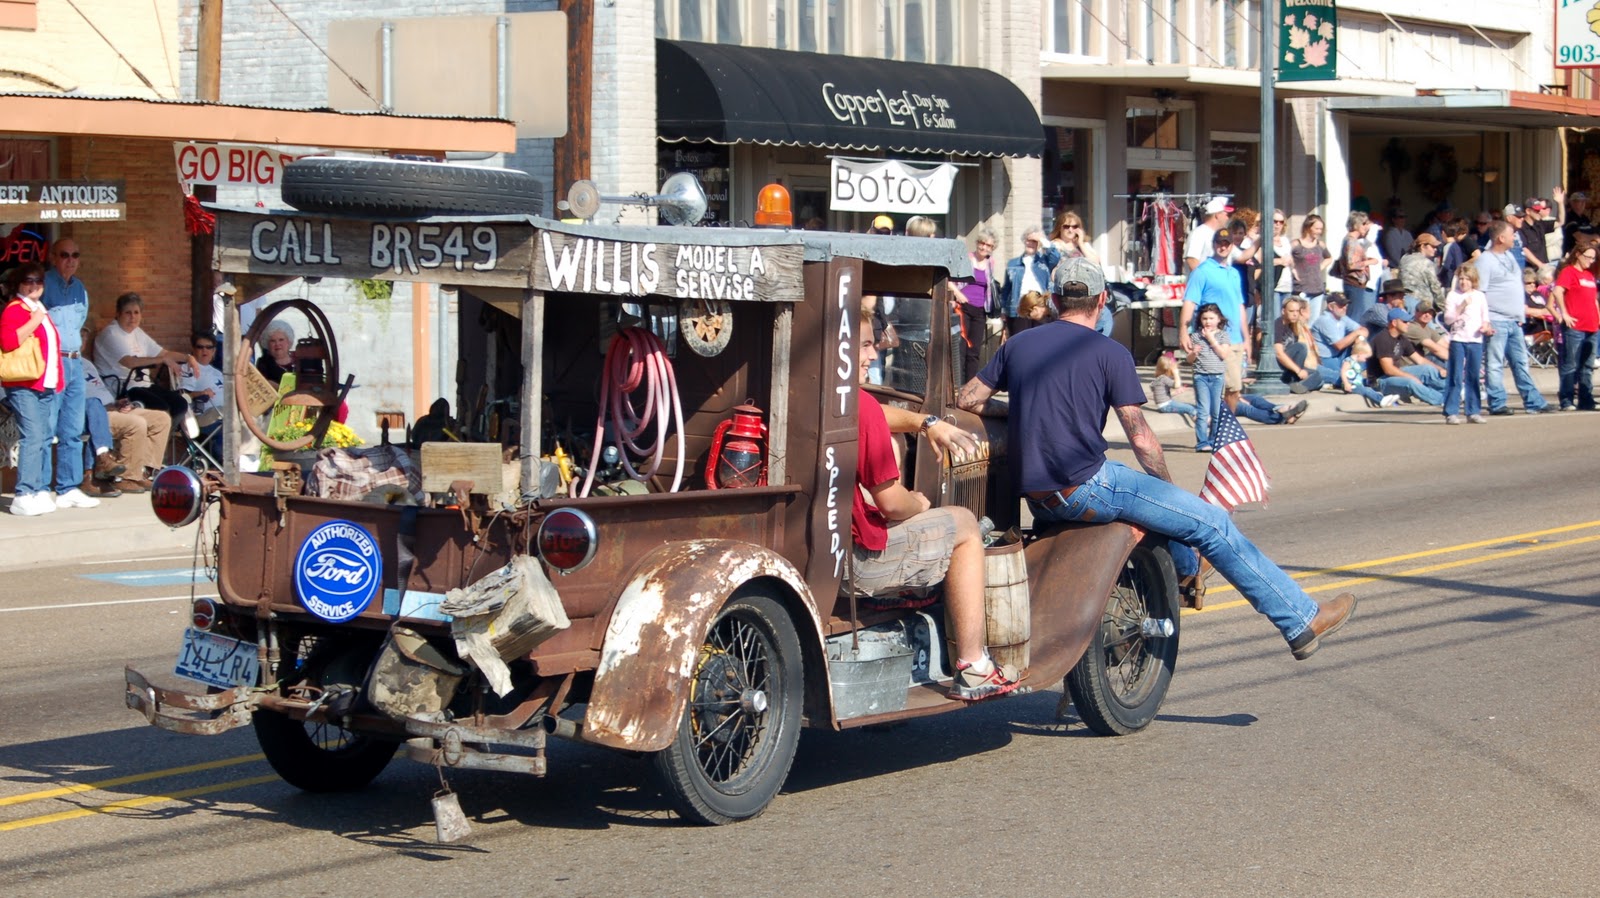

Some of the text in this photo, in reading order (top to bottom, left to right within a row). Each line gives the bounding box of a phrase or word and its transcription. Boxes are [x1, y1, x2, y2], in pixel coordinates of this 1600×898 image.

[912, 94, 932, 111] Day
[931, 94, 950, 112] Spa
[923, 113, 956, 129] & Salon
[178, 145, 275, 184] GO BIG
[39, 185, 118, 205] ANTIQUES
[834, 164, 936, 205] Botox
[40, 208, 120, 219] AND COLLECTIBLES
[251, 219, 498, 275] CALL BR549
[676, 244, 765, 275] MODEL A
[542, 231, 660, 296] WILLIS
[836, 275, 851, 416] FAST
[825, 446, 844, 578] SPEEDY
[311, 525, 373, 557] AUTHORIZED
[306, 553, 368, 586] Ford
[308, 595, 355, 617] SERVICE
